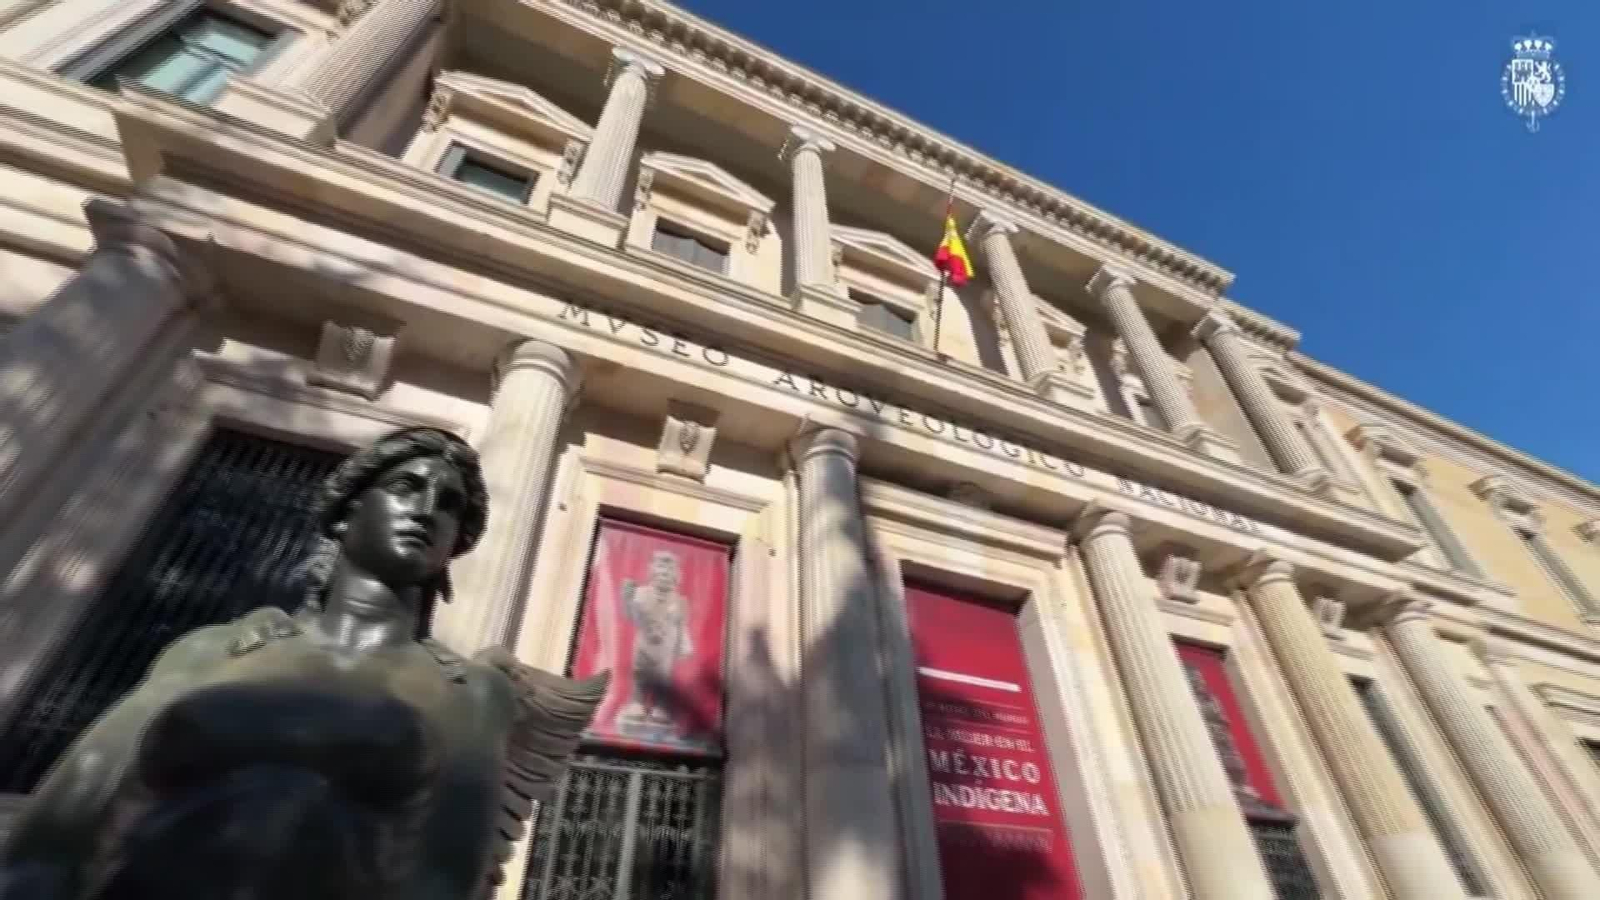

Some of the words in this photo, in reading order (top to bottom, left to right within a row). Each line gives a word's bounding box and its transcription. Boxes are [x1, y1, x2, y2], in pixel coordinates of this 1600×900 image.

[558, 303, 730, 367] MVSEO
[929, 749, 1041, 783] MÉXICO
[933, 779, 1050, 817] INDÍGENA
